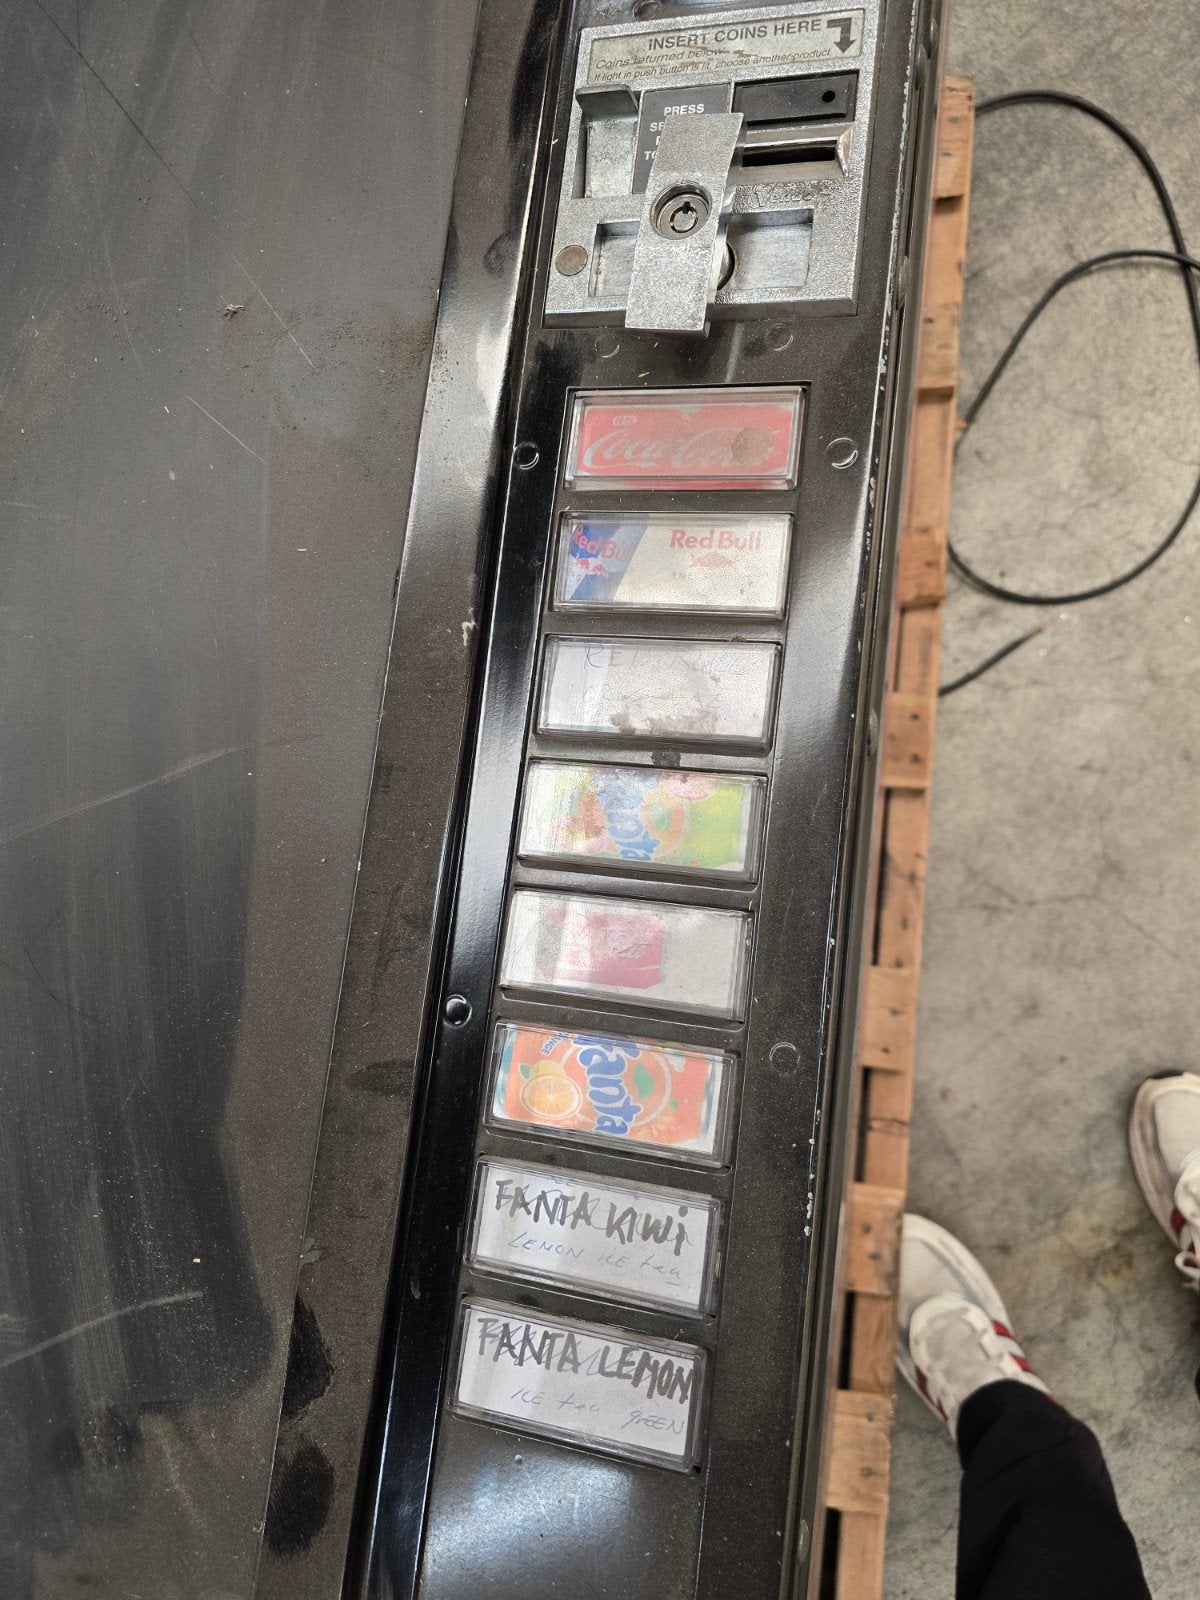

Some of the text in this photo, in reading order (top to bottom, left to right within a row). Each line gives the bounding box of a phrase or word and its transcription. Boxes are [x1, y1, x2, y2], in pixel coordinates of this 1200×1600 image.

[714, 25, 767, 43] COINS
[773, 18, 822, 36] HERE
[596, 58, 630, 70] Coins
[633, 50, 684, 64] returned
[602, 70, 622, 82] light
[623, 71, 632, 79] in
[633, 67, 657, 80] push
[659, 64, 688, 75] button
[690, 63, 699, 71] is
[714, 57, 750, 69] choose
[754, 53, 790, 65] another
[792, 48, 832, 61] product
[664, 103, 705, 117] PRESS
[669, 528, 763, 552] Red Bull
[495, 1179, 592, 1231] FANTA
[508, 1231, 585, 1259] LEMON
[597, 1252, 629, 1268] ICE
[477, 1317, 694, 1405] FANTA LEMON
[511, 1387, 545, 1405] ICE
